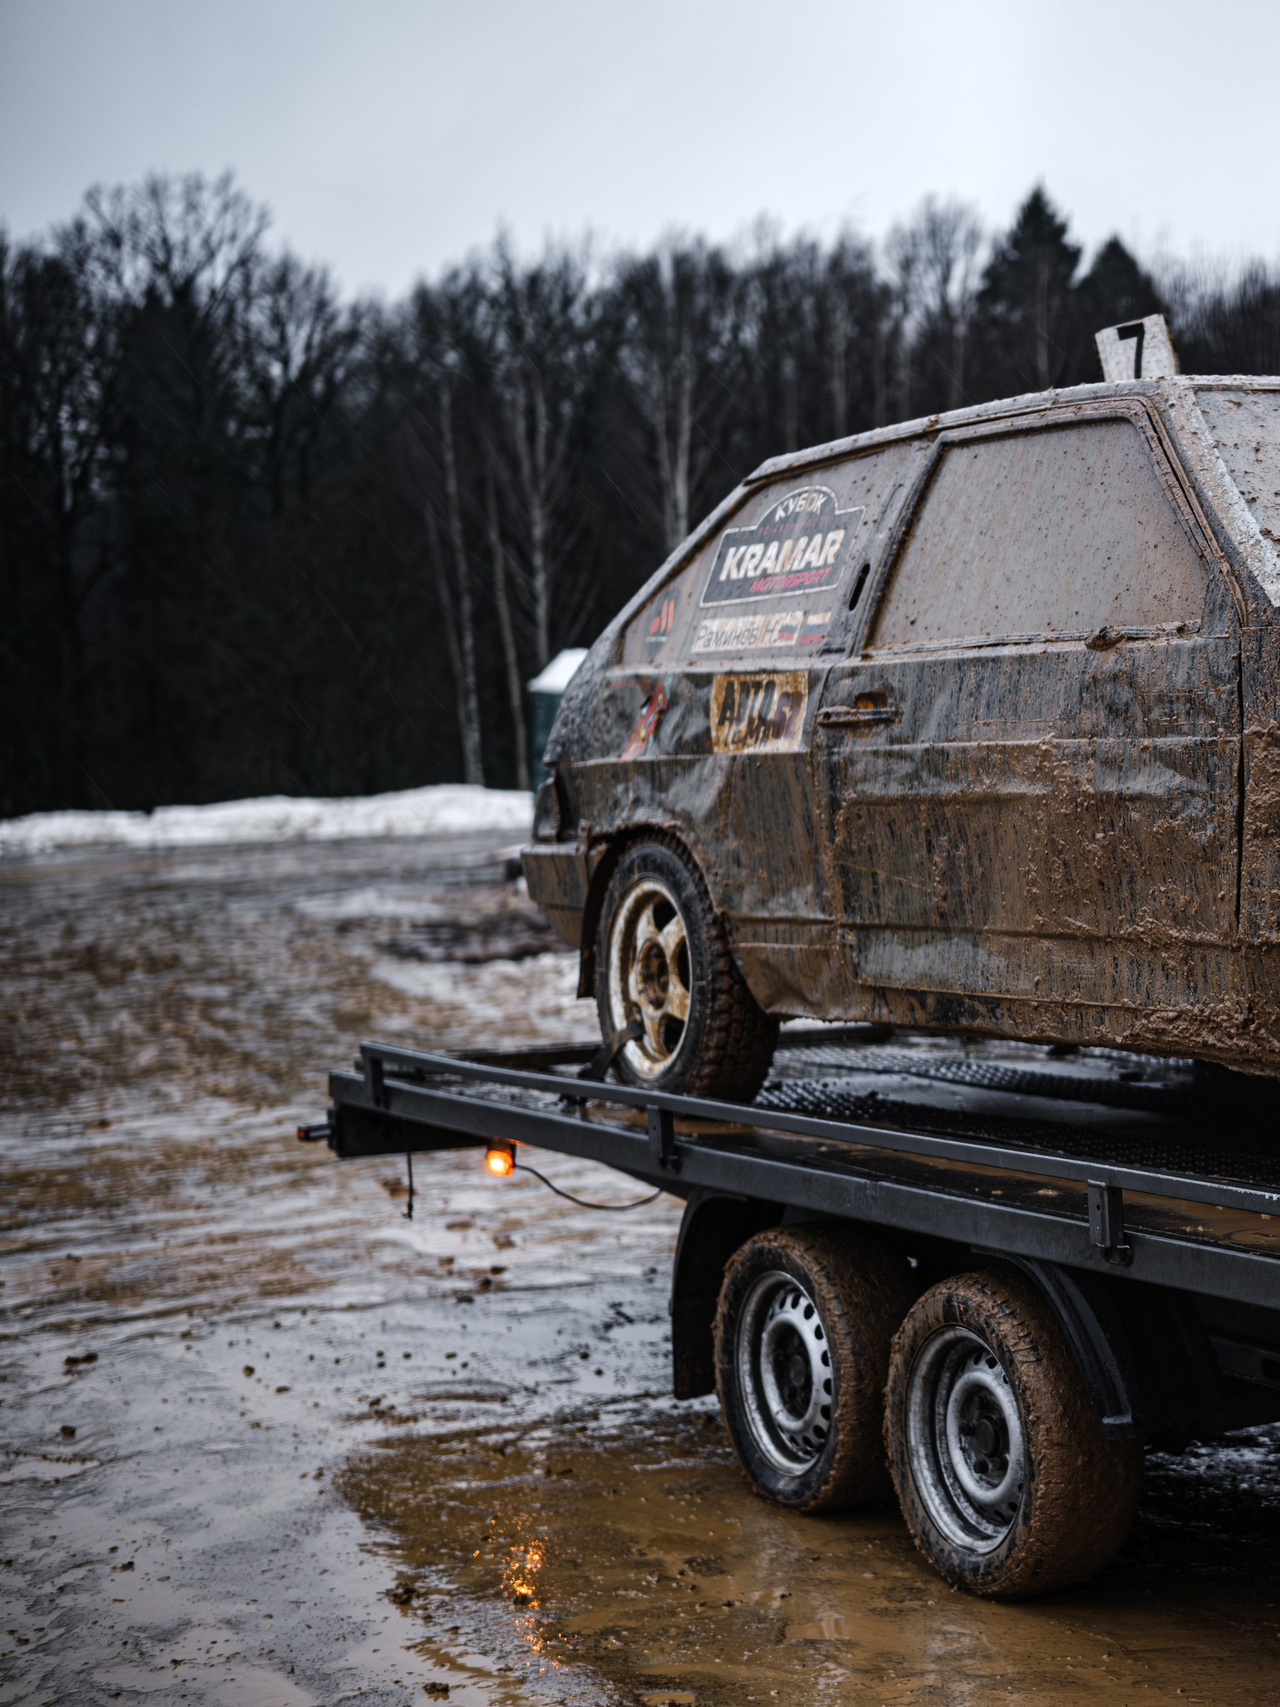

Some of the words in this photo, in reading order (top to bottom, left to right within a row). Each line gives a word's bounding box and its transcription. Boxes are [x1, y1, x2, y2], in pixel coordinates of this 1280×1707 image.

[1116, 322, 1145, 379] 7
[775, 492, 828, 522] КУБОК
[718, 528, 846, 582] KRAMAR
[749, 566, 833, 594] MOTORSPORT
